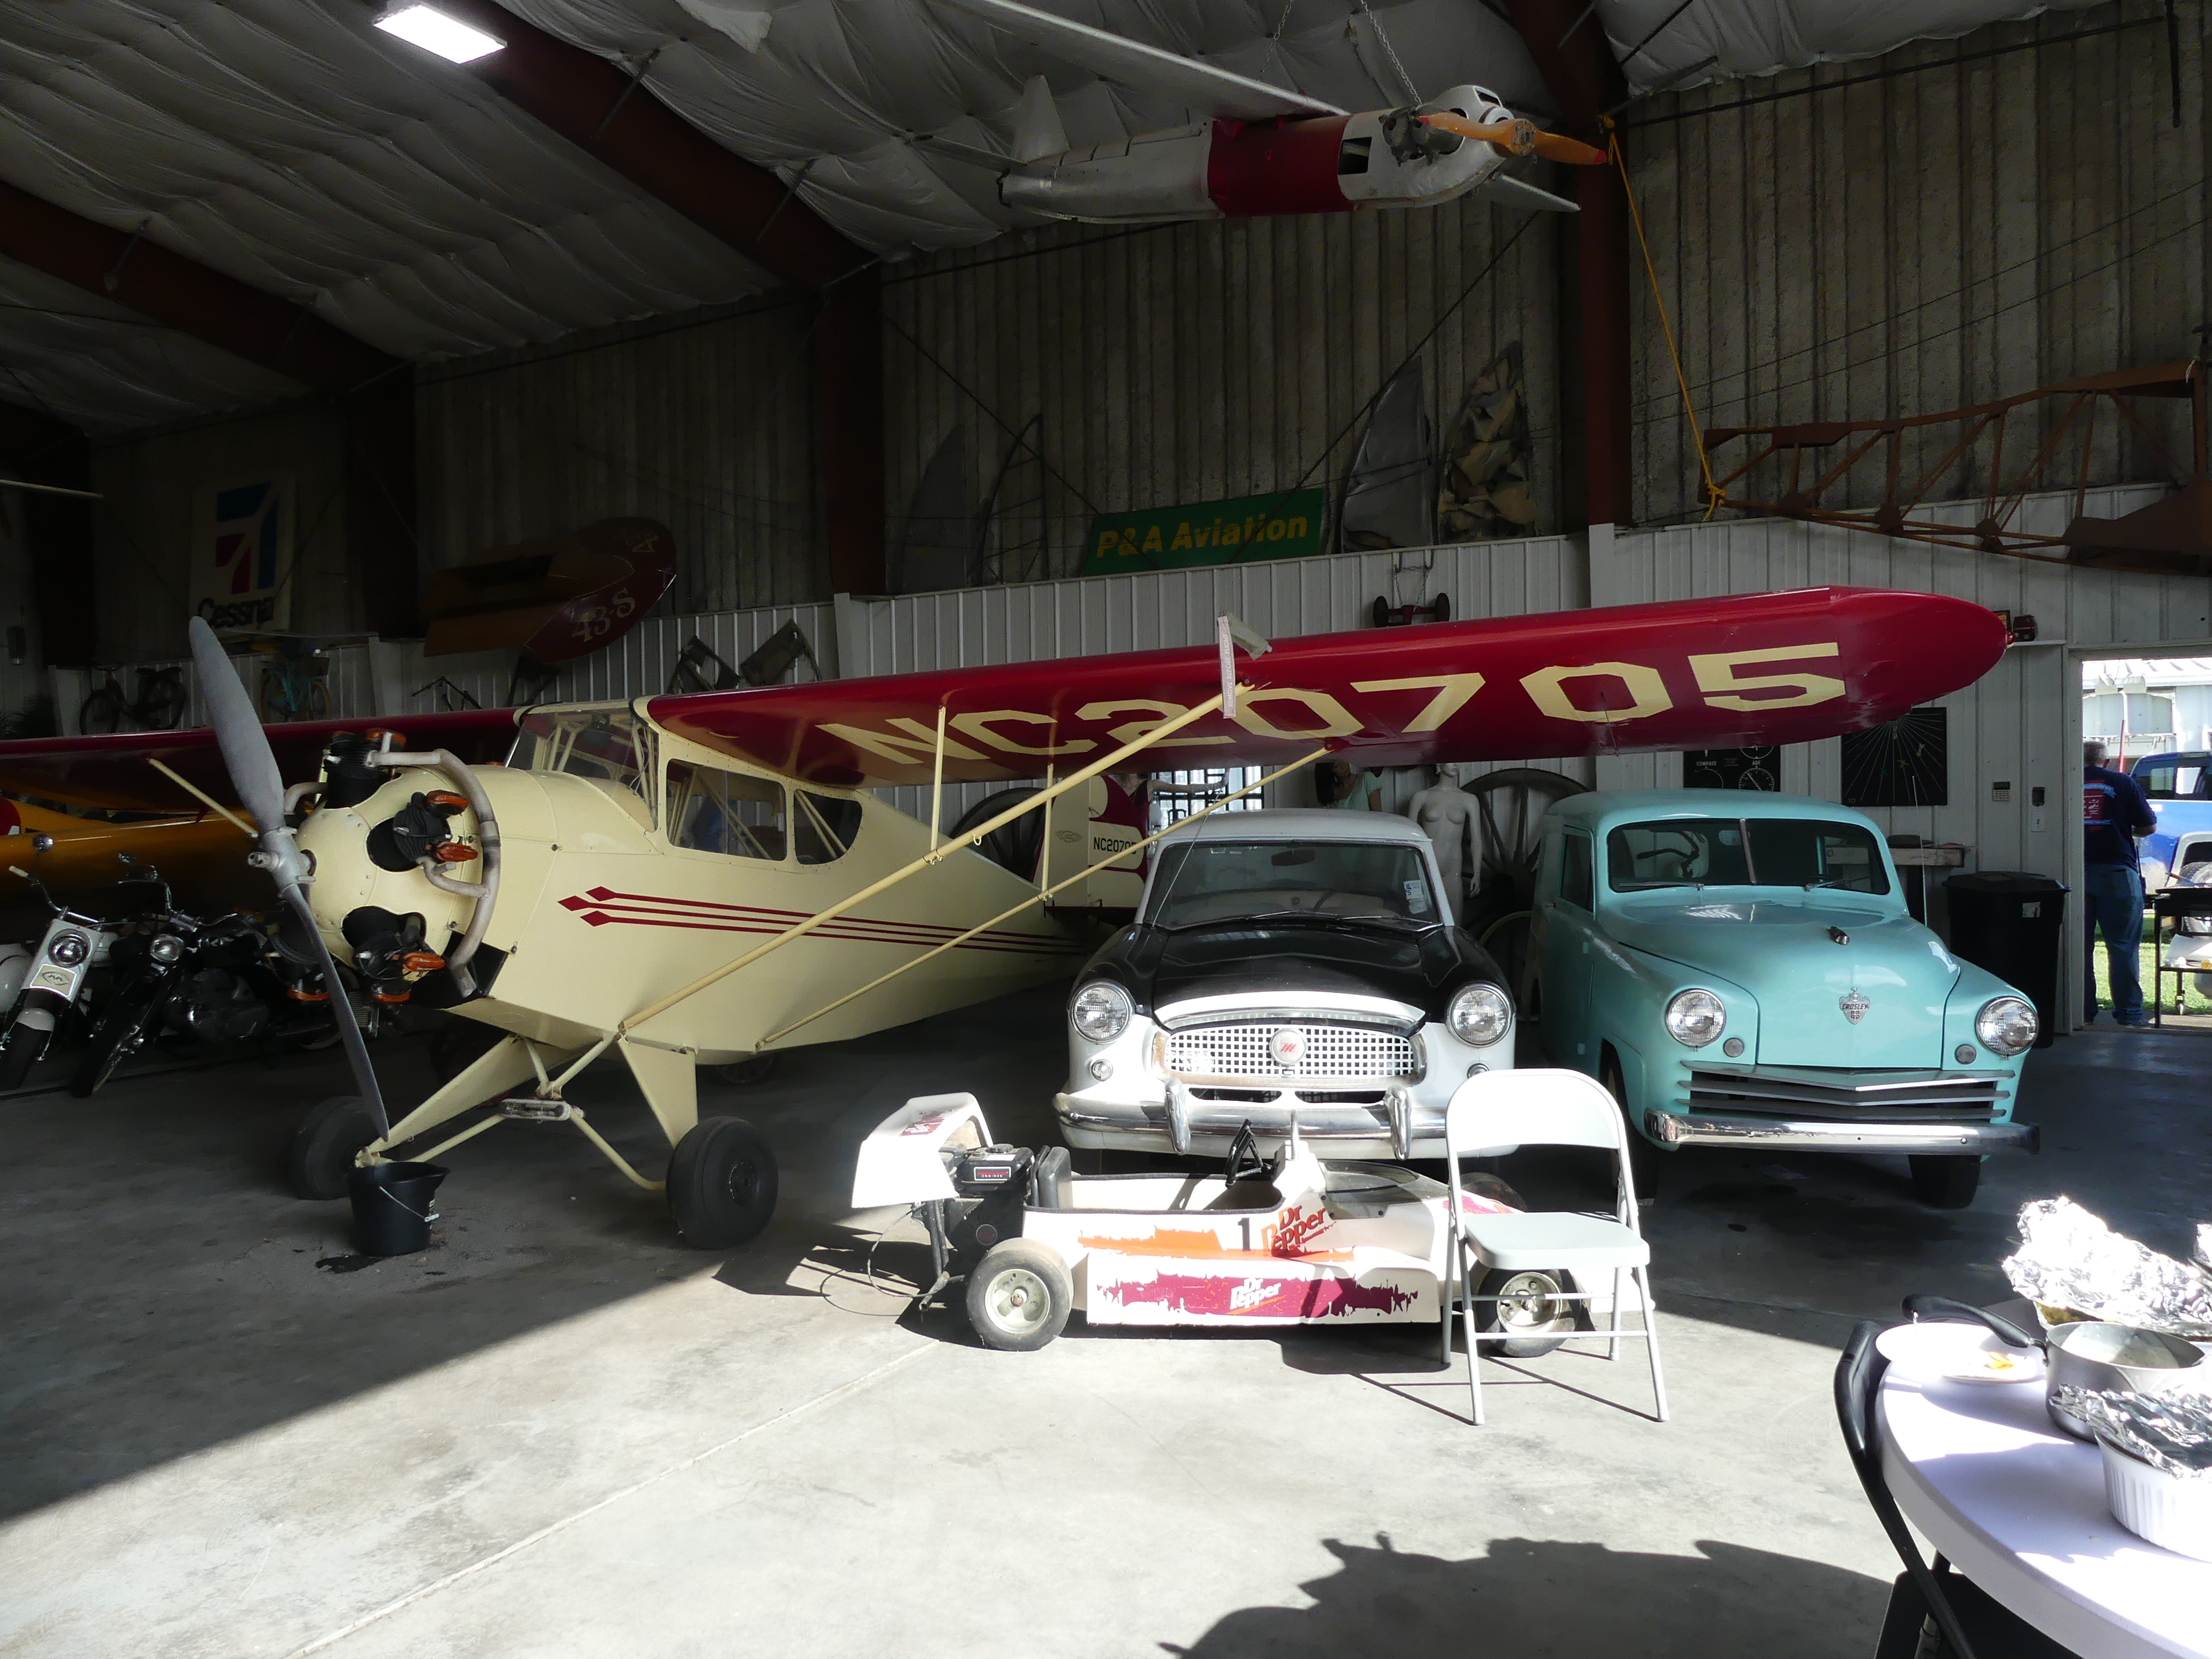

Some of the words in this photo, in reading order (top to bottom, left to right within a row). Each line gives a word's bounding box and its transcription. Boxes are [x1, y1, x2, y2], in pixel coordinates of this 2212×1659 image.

[1096, 525, 1162, 558] P&A
[1170, 512, 1307, 551] Aviation
[1224, 656, 1233, 680] BEFORE
[814, 641, 1846, 765] NC20705
[1238, 1217, 1251, 1252] 1
[1261, 1207, 1326, 1252] Pepper
[1278, 1204, 1302, 1231] Dr
